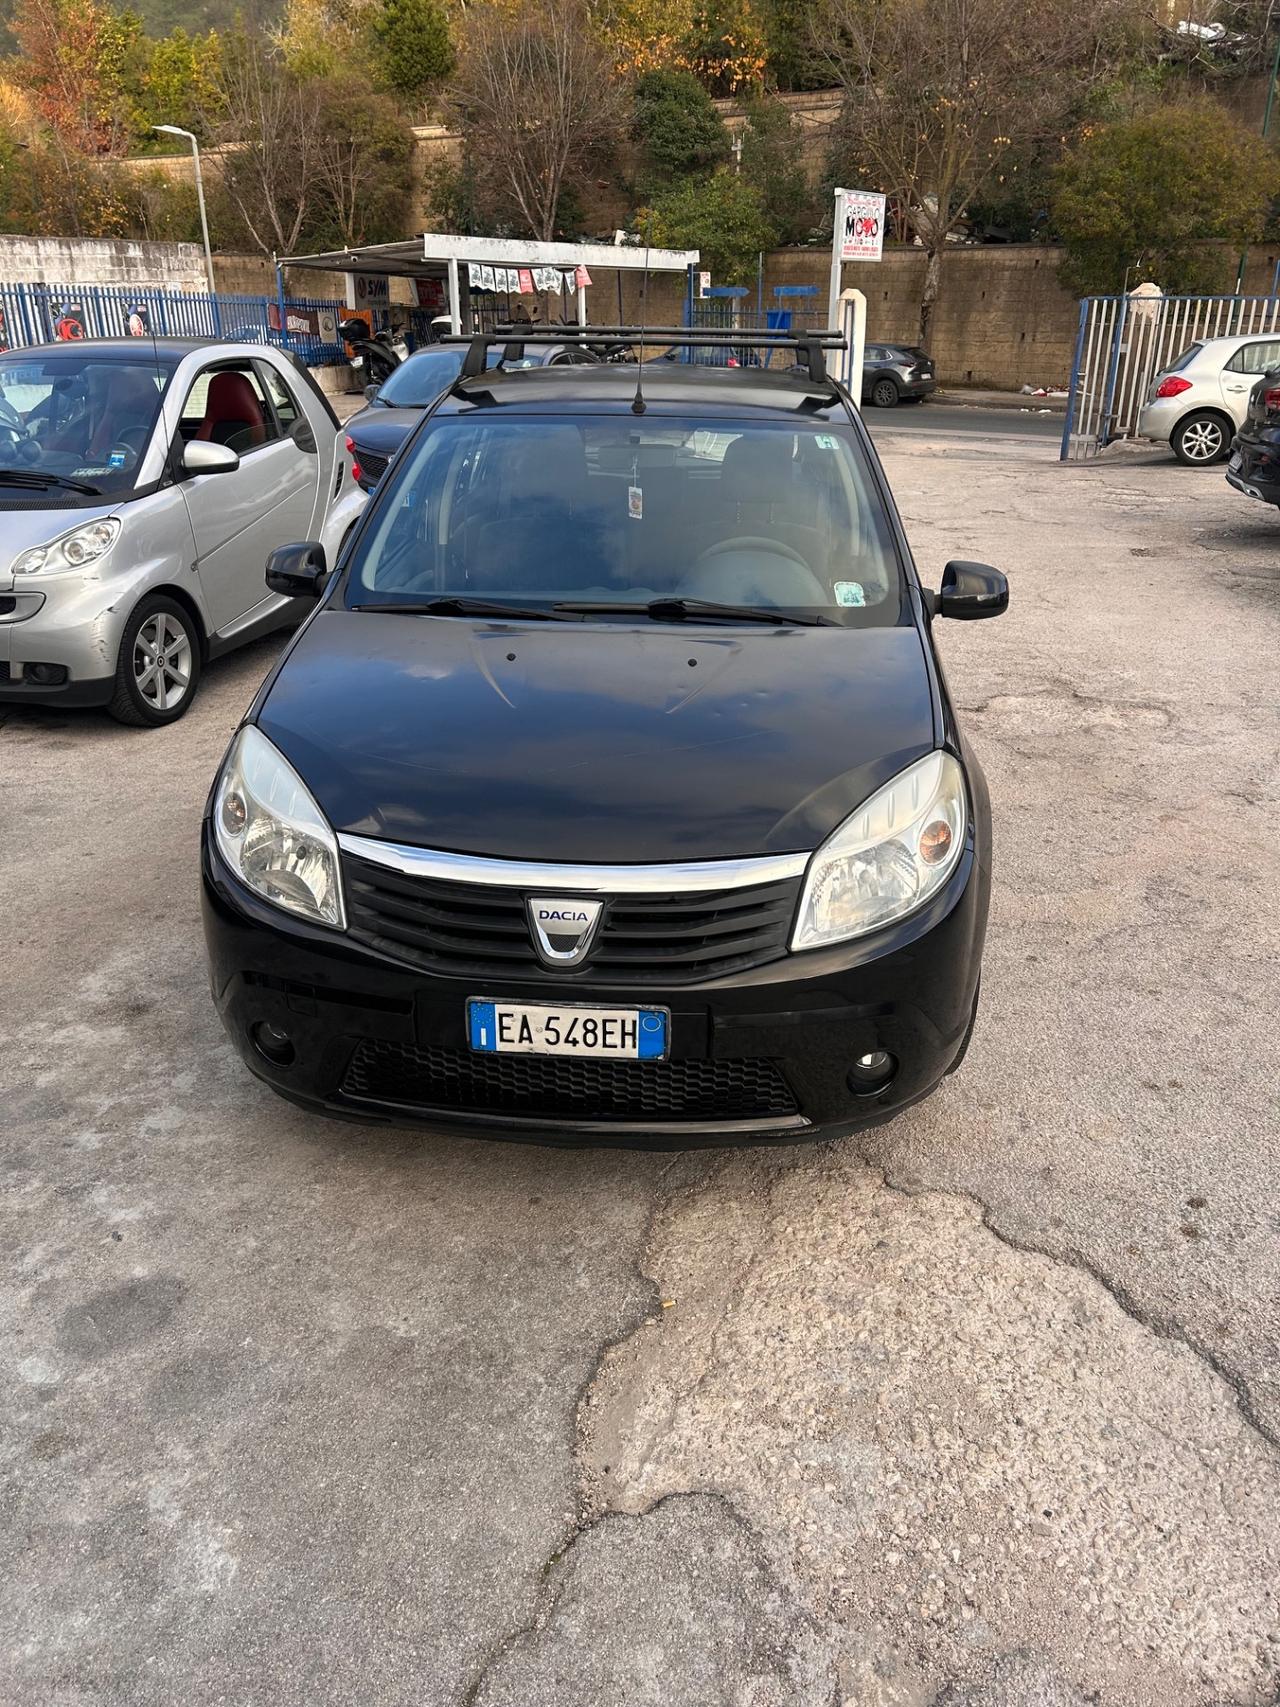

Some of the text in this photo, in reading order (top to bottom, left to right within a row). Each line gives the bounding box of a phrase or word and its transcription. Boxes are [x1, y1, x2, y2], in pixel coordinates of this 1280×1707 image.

[845, 216, 879, 238] MOO
[368, 279, 387, 297] SYM
[539, 910, 588, 921] DACIA
[498, 1012, 533, 1044] EA
[545, 1016, 637, 1050] 548EH
